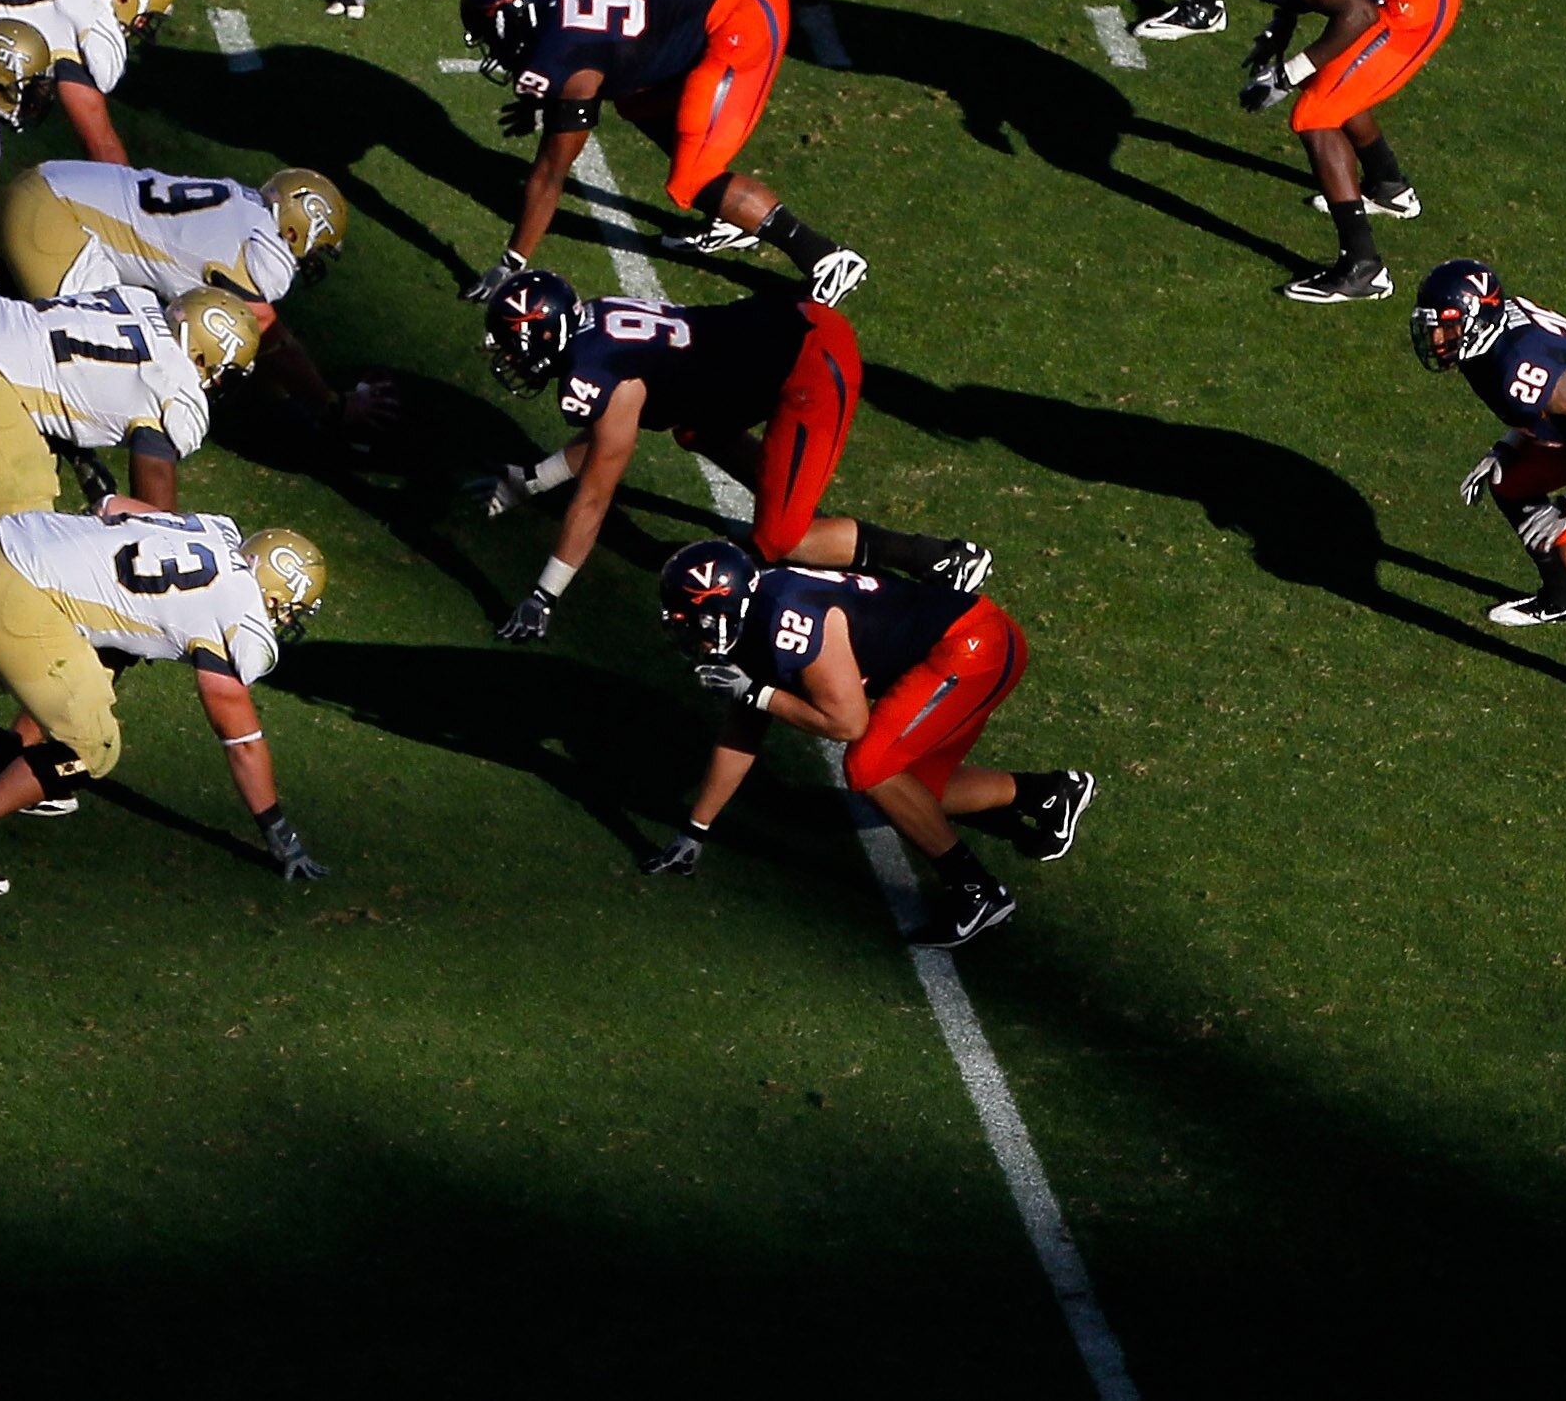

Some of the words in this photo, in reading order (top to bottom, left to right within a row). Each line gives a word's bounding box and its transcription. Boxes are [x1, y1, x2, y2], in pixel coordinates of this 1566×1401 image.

[32, 287, 153, 365] 77
[561, 377, 601, 417] 94
[1509, 361, 1550, 405] 26
[688, 561, 716, 589] V
[775, 609, 815, 655] 92
